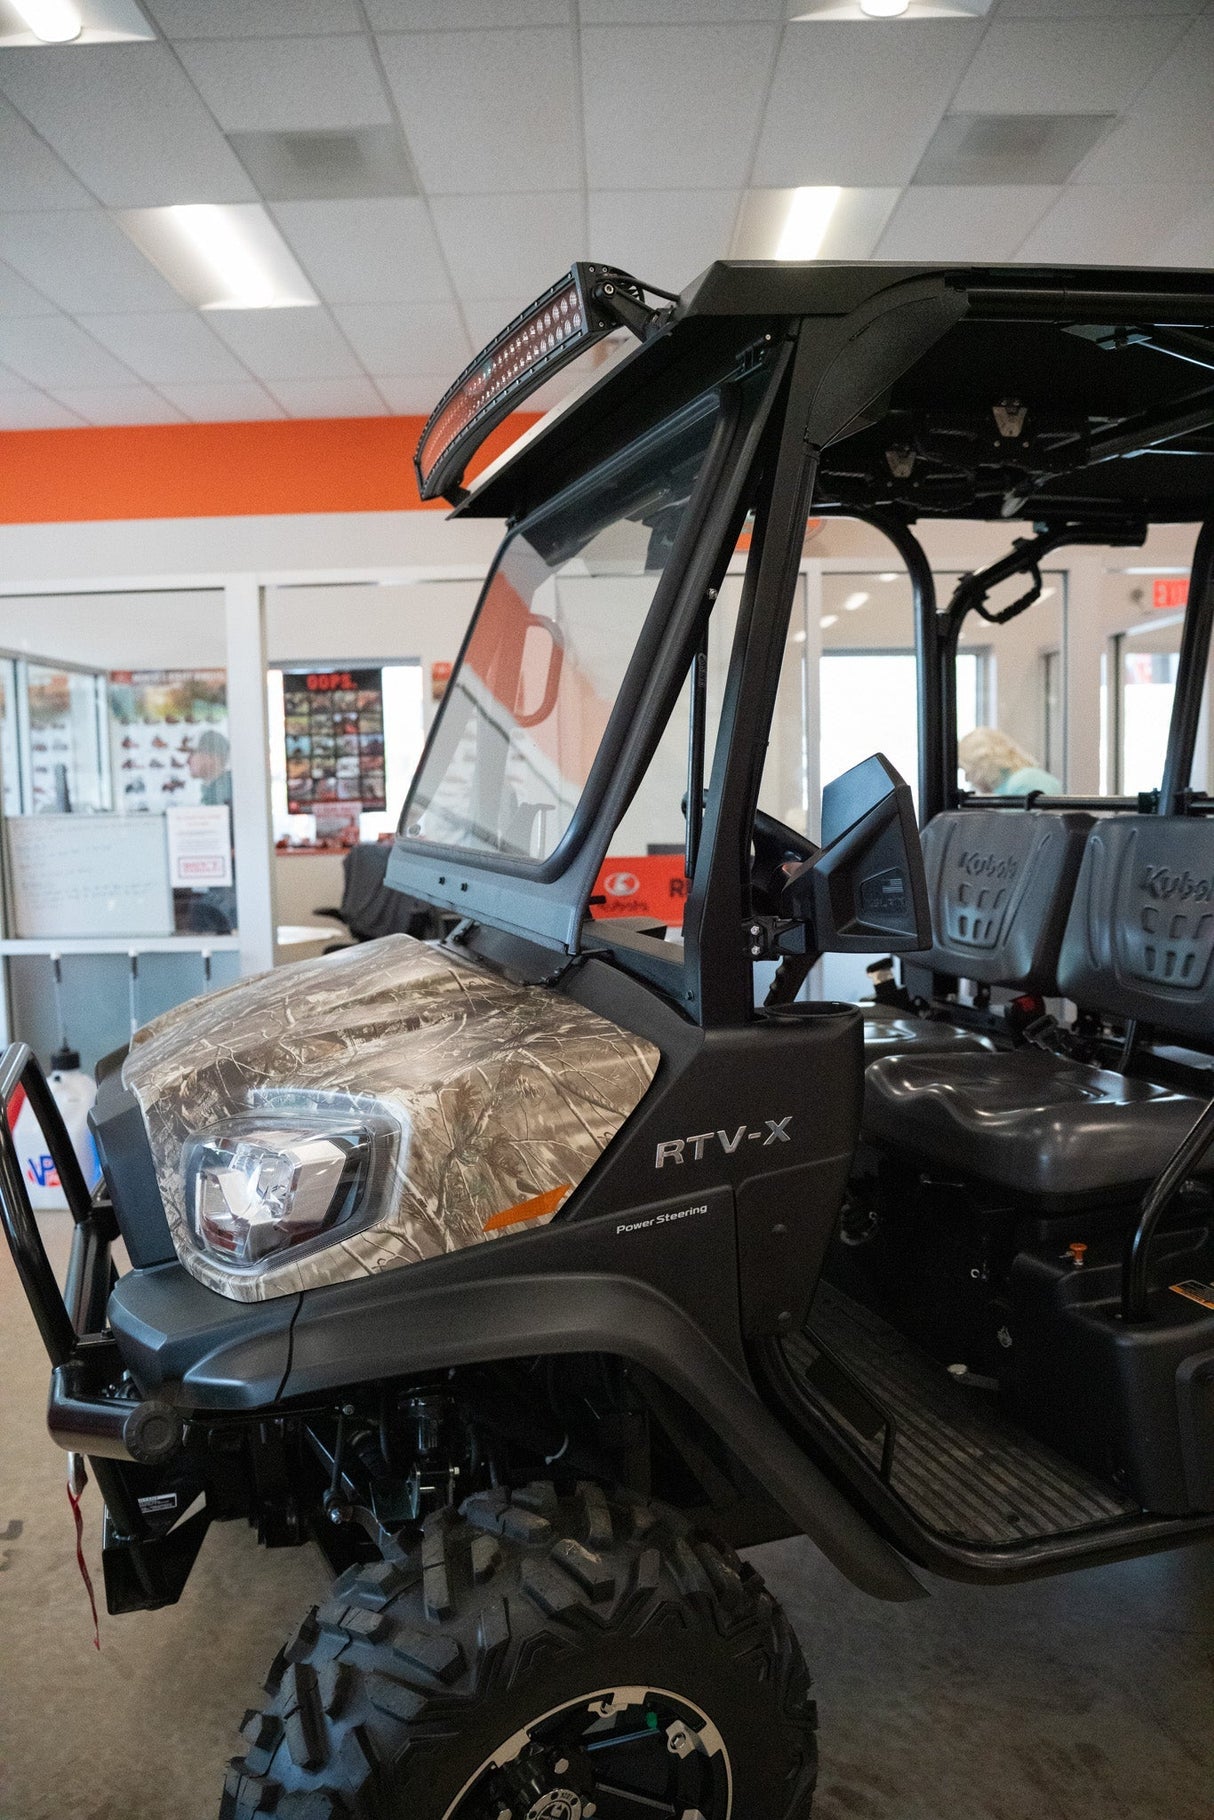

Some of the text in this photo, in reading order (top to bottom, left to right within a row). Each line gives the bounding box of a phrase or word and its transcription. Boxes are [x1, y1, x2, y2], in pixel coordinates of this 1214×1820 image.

[1139, 865, 1214, 902] Kubo
[655, 1116, 793, 1169] RTV-X
[616, 1205, 708, 1234] Power Steering
